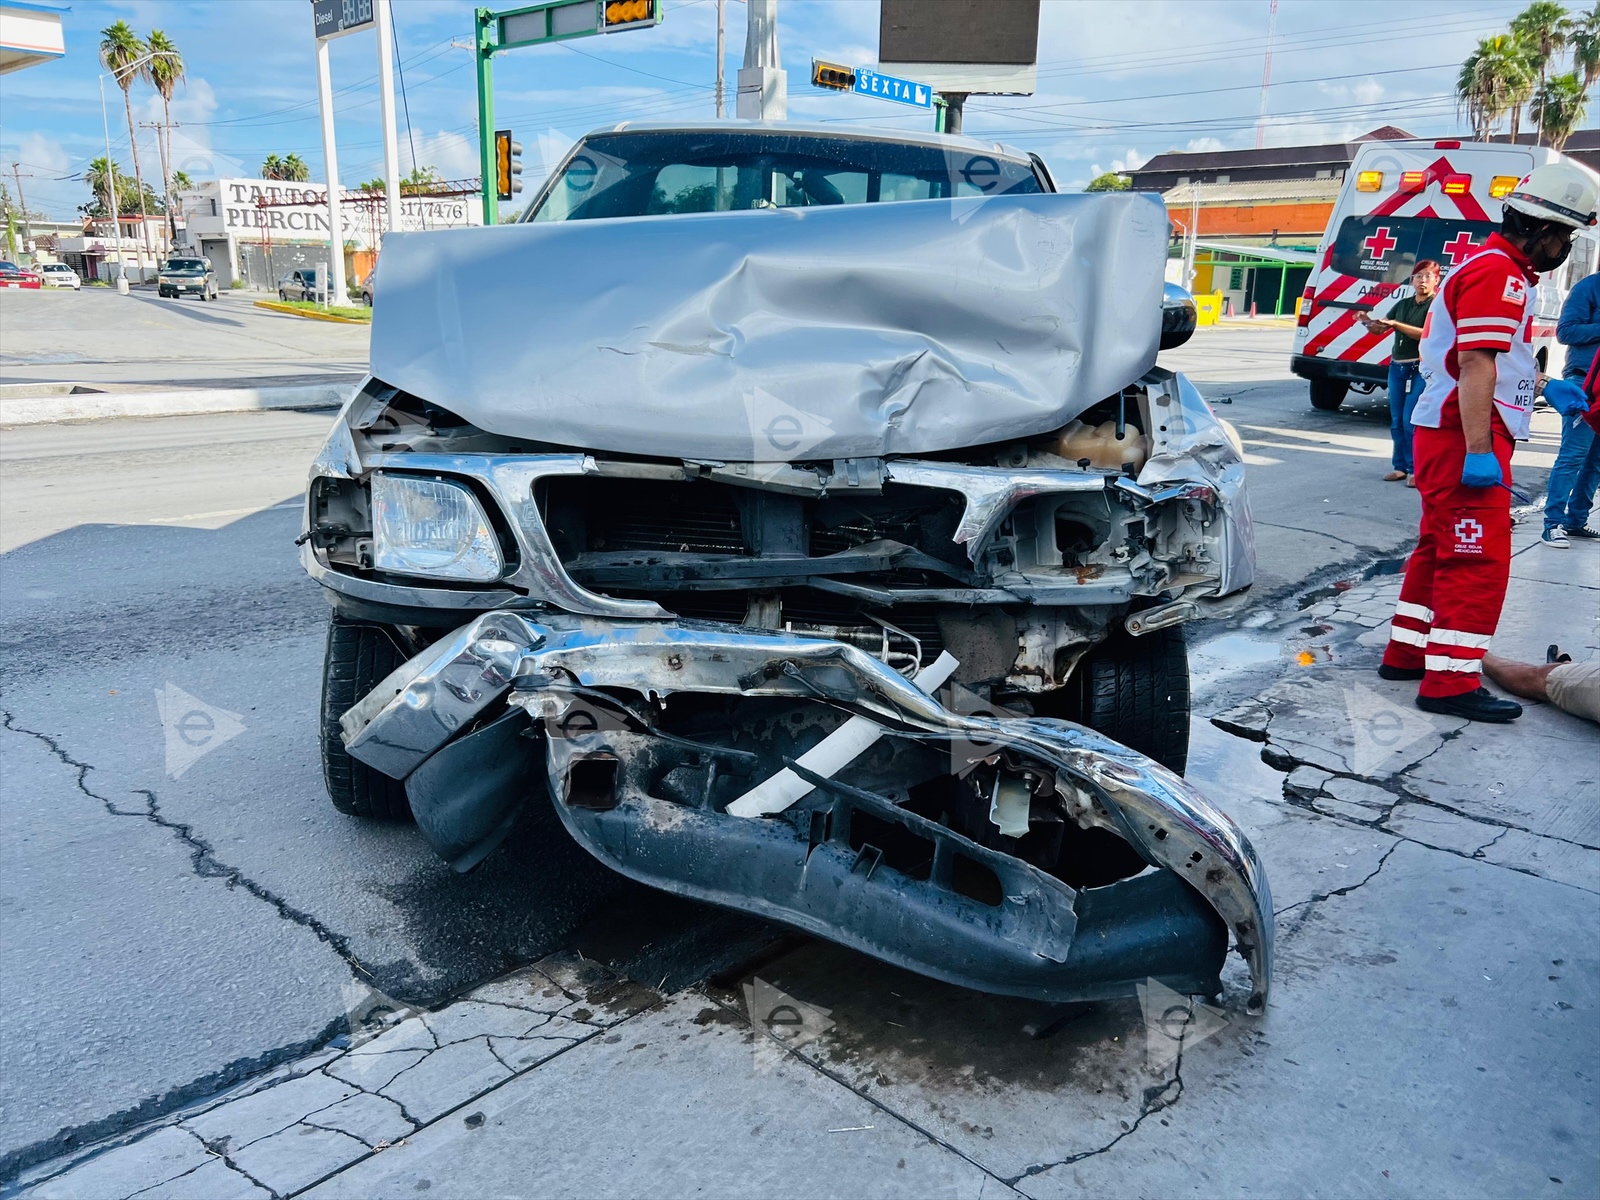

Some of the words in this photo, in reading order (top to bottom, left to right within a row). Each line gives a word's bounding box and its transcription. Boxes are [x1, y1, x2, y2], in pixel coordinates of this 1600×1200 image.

[316, 9, 333, 26] Diesel
[861, 74, 910, 100] SEXTA
[226, 208, 350, 232] PIERCING
